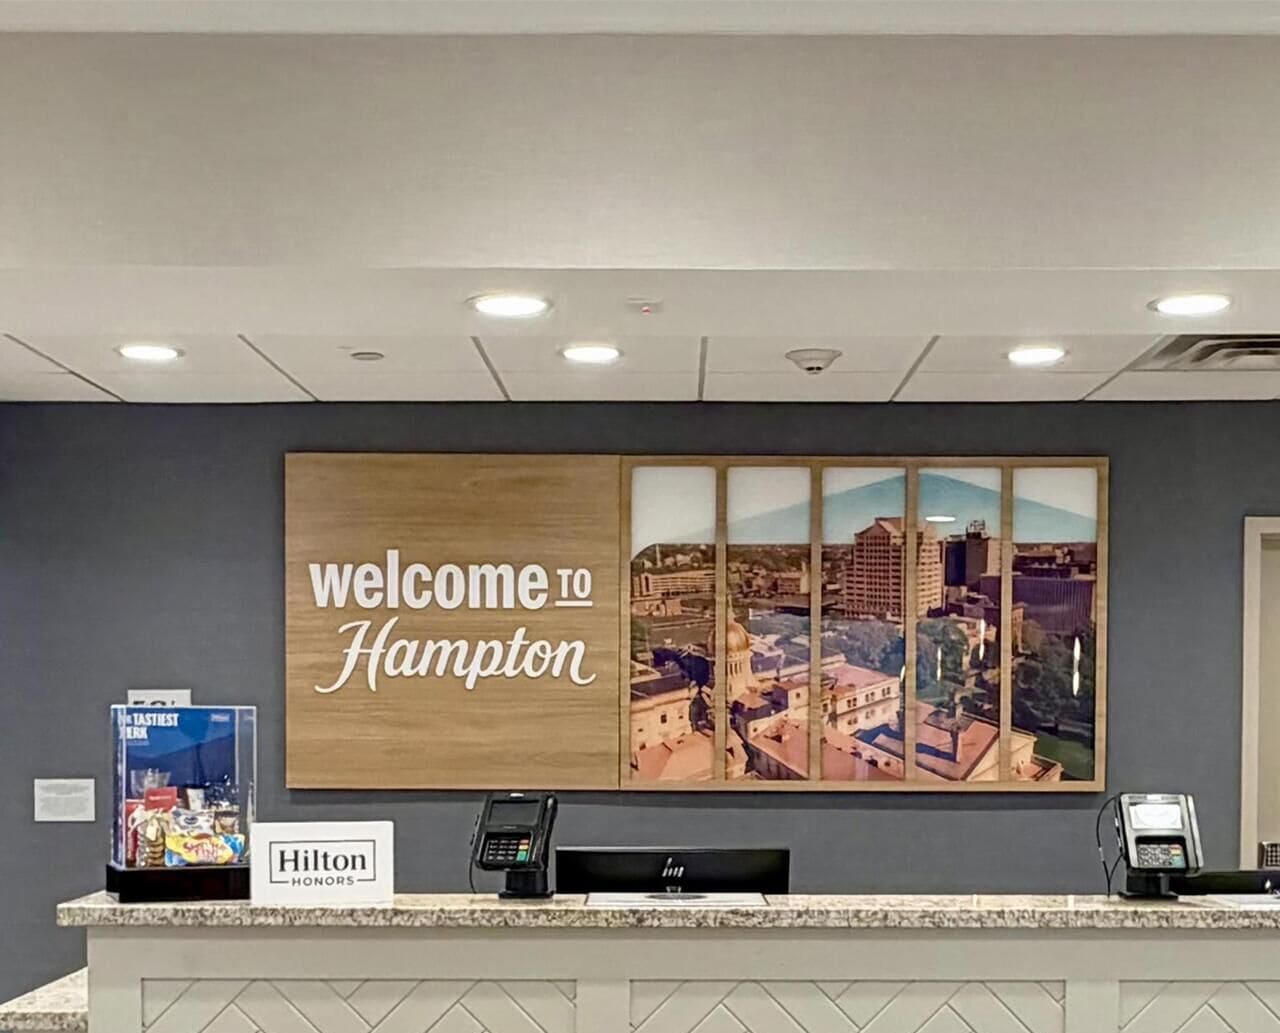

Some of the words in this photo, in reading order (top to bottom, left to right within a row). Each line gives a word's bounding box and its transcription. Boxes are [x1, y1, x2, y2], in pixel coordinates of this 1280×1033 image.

[308, 549, 549, 610] welcome
[556, 567, 593, 600] TO
[314, 616, 597, 693] Hampton
[132, 713, 179, 727] TASTIEST
[278, 849, 367, 872] Hilton
[292, 876, 355, 887] HONORS
